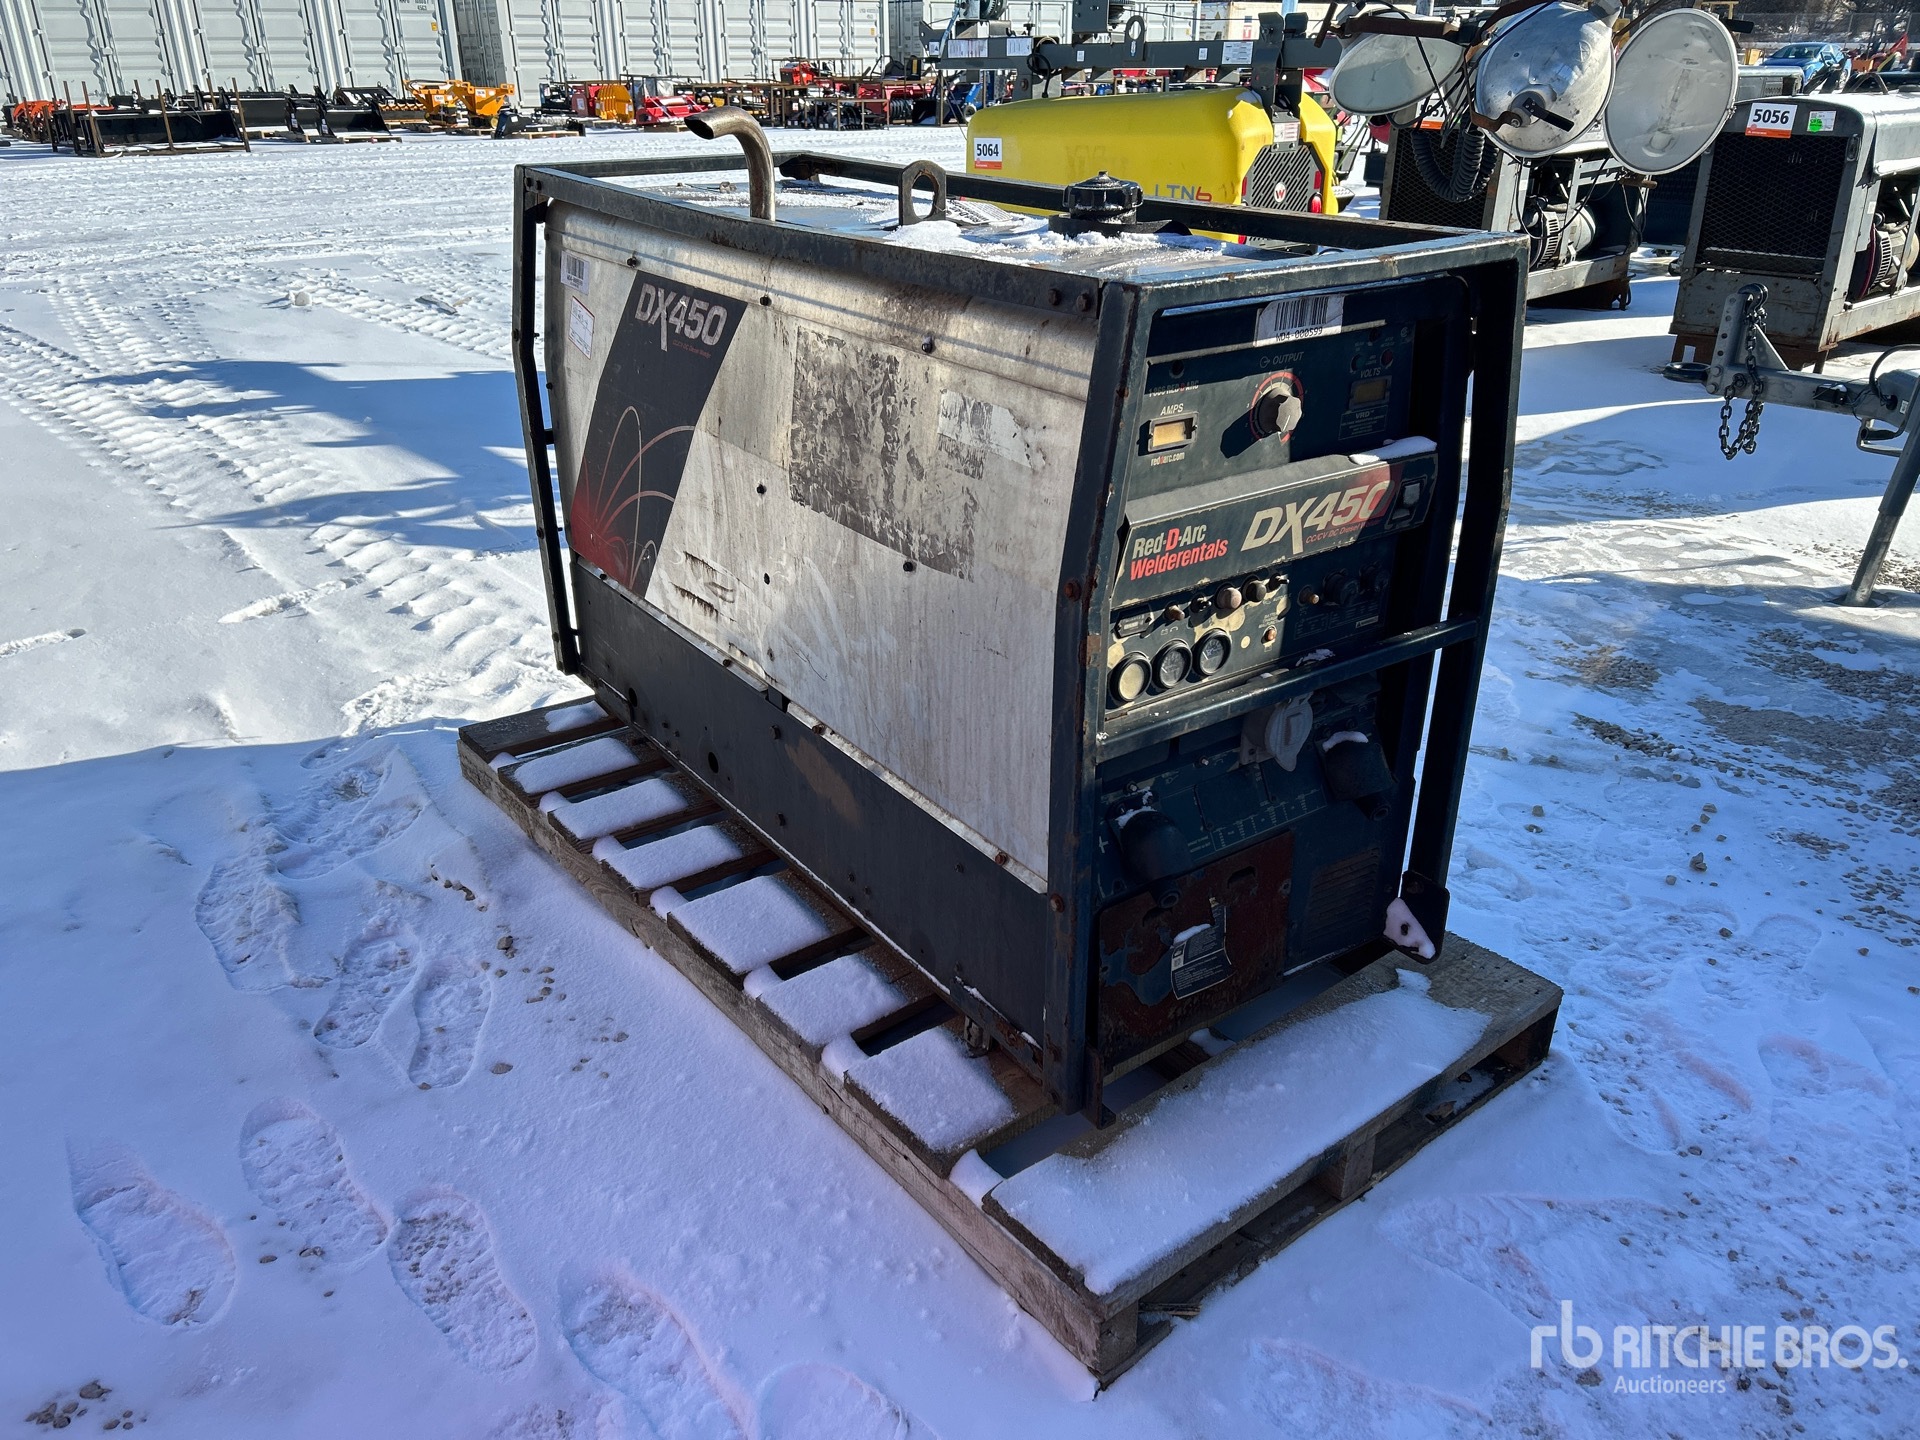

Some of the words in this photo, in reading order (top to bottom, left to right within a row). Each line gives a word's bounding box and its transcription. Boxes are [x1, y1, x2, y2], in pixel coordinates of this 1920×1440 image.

[1752, 108, 1790, 124] 5056
[976, 143, 999, 157] 5064
[634, 282, 728, 352] DX450
[1272, 351, 1304, 365] OUTPUT
[1360, 367, 1381, 379] VOLTS
[1160, 403, 1184, 416] AMPS
[1241, 479, 1395, 555] DX450
[1132, 524, 1207, 560] Red-D-Arc
[1130, 538, 1229, 581] Welderentals
